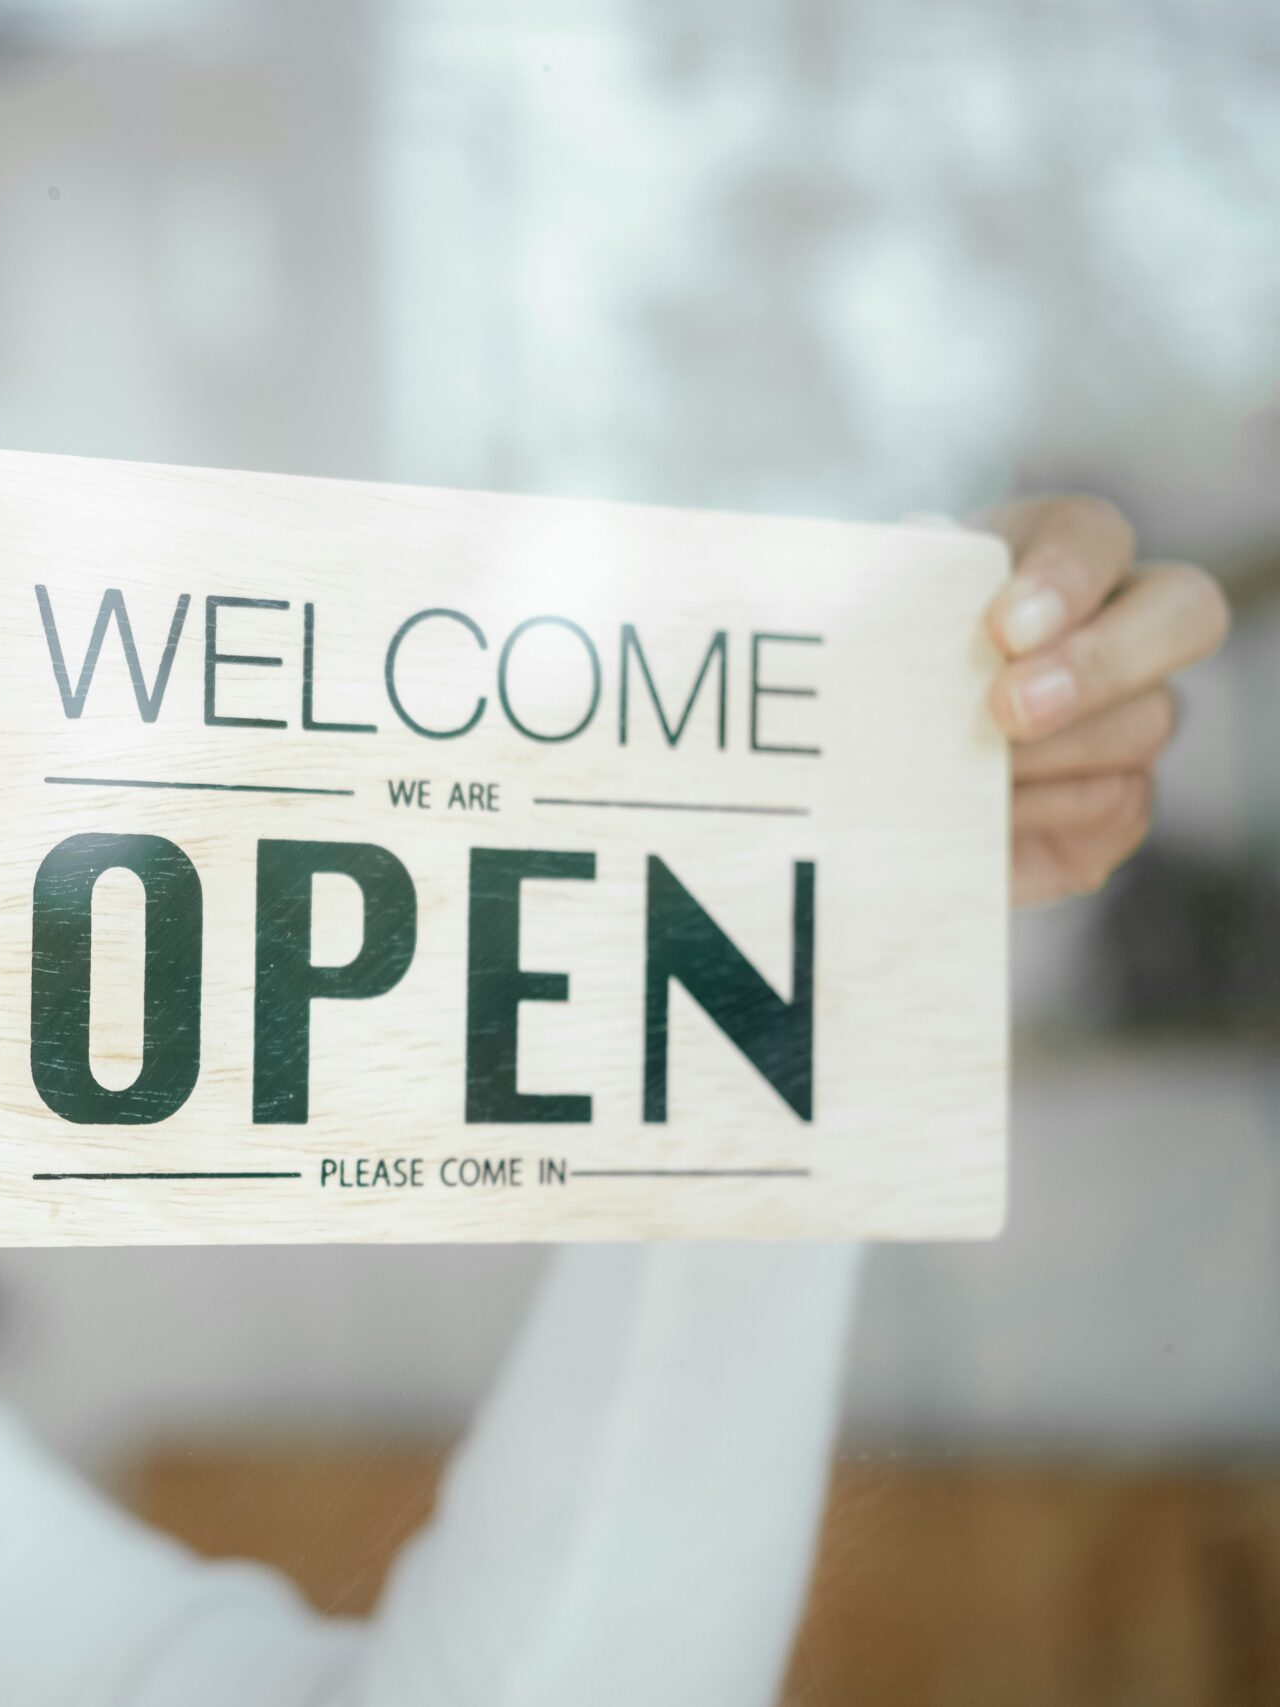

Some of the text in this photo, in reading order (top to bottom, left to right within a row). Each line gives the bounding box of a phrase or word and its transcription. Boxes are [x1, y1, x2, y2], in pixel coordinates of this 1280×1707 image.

[34, 583, 825, 757] WELCOME
[387, 779, 500, 812] WE ARE
[30, 832, 816, 1126] OPEN
[320, 1157, 567, 1188] PLEASE COME IN
